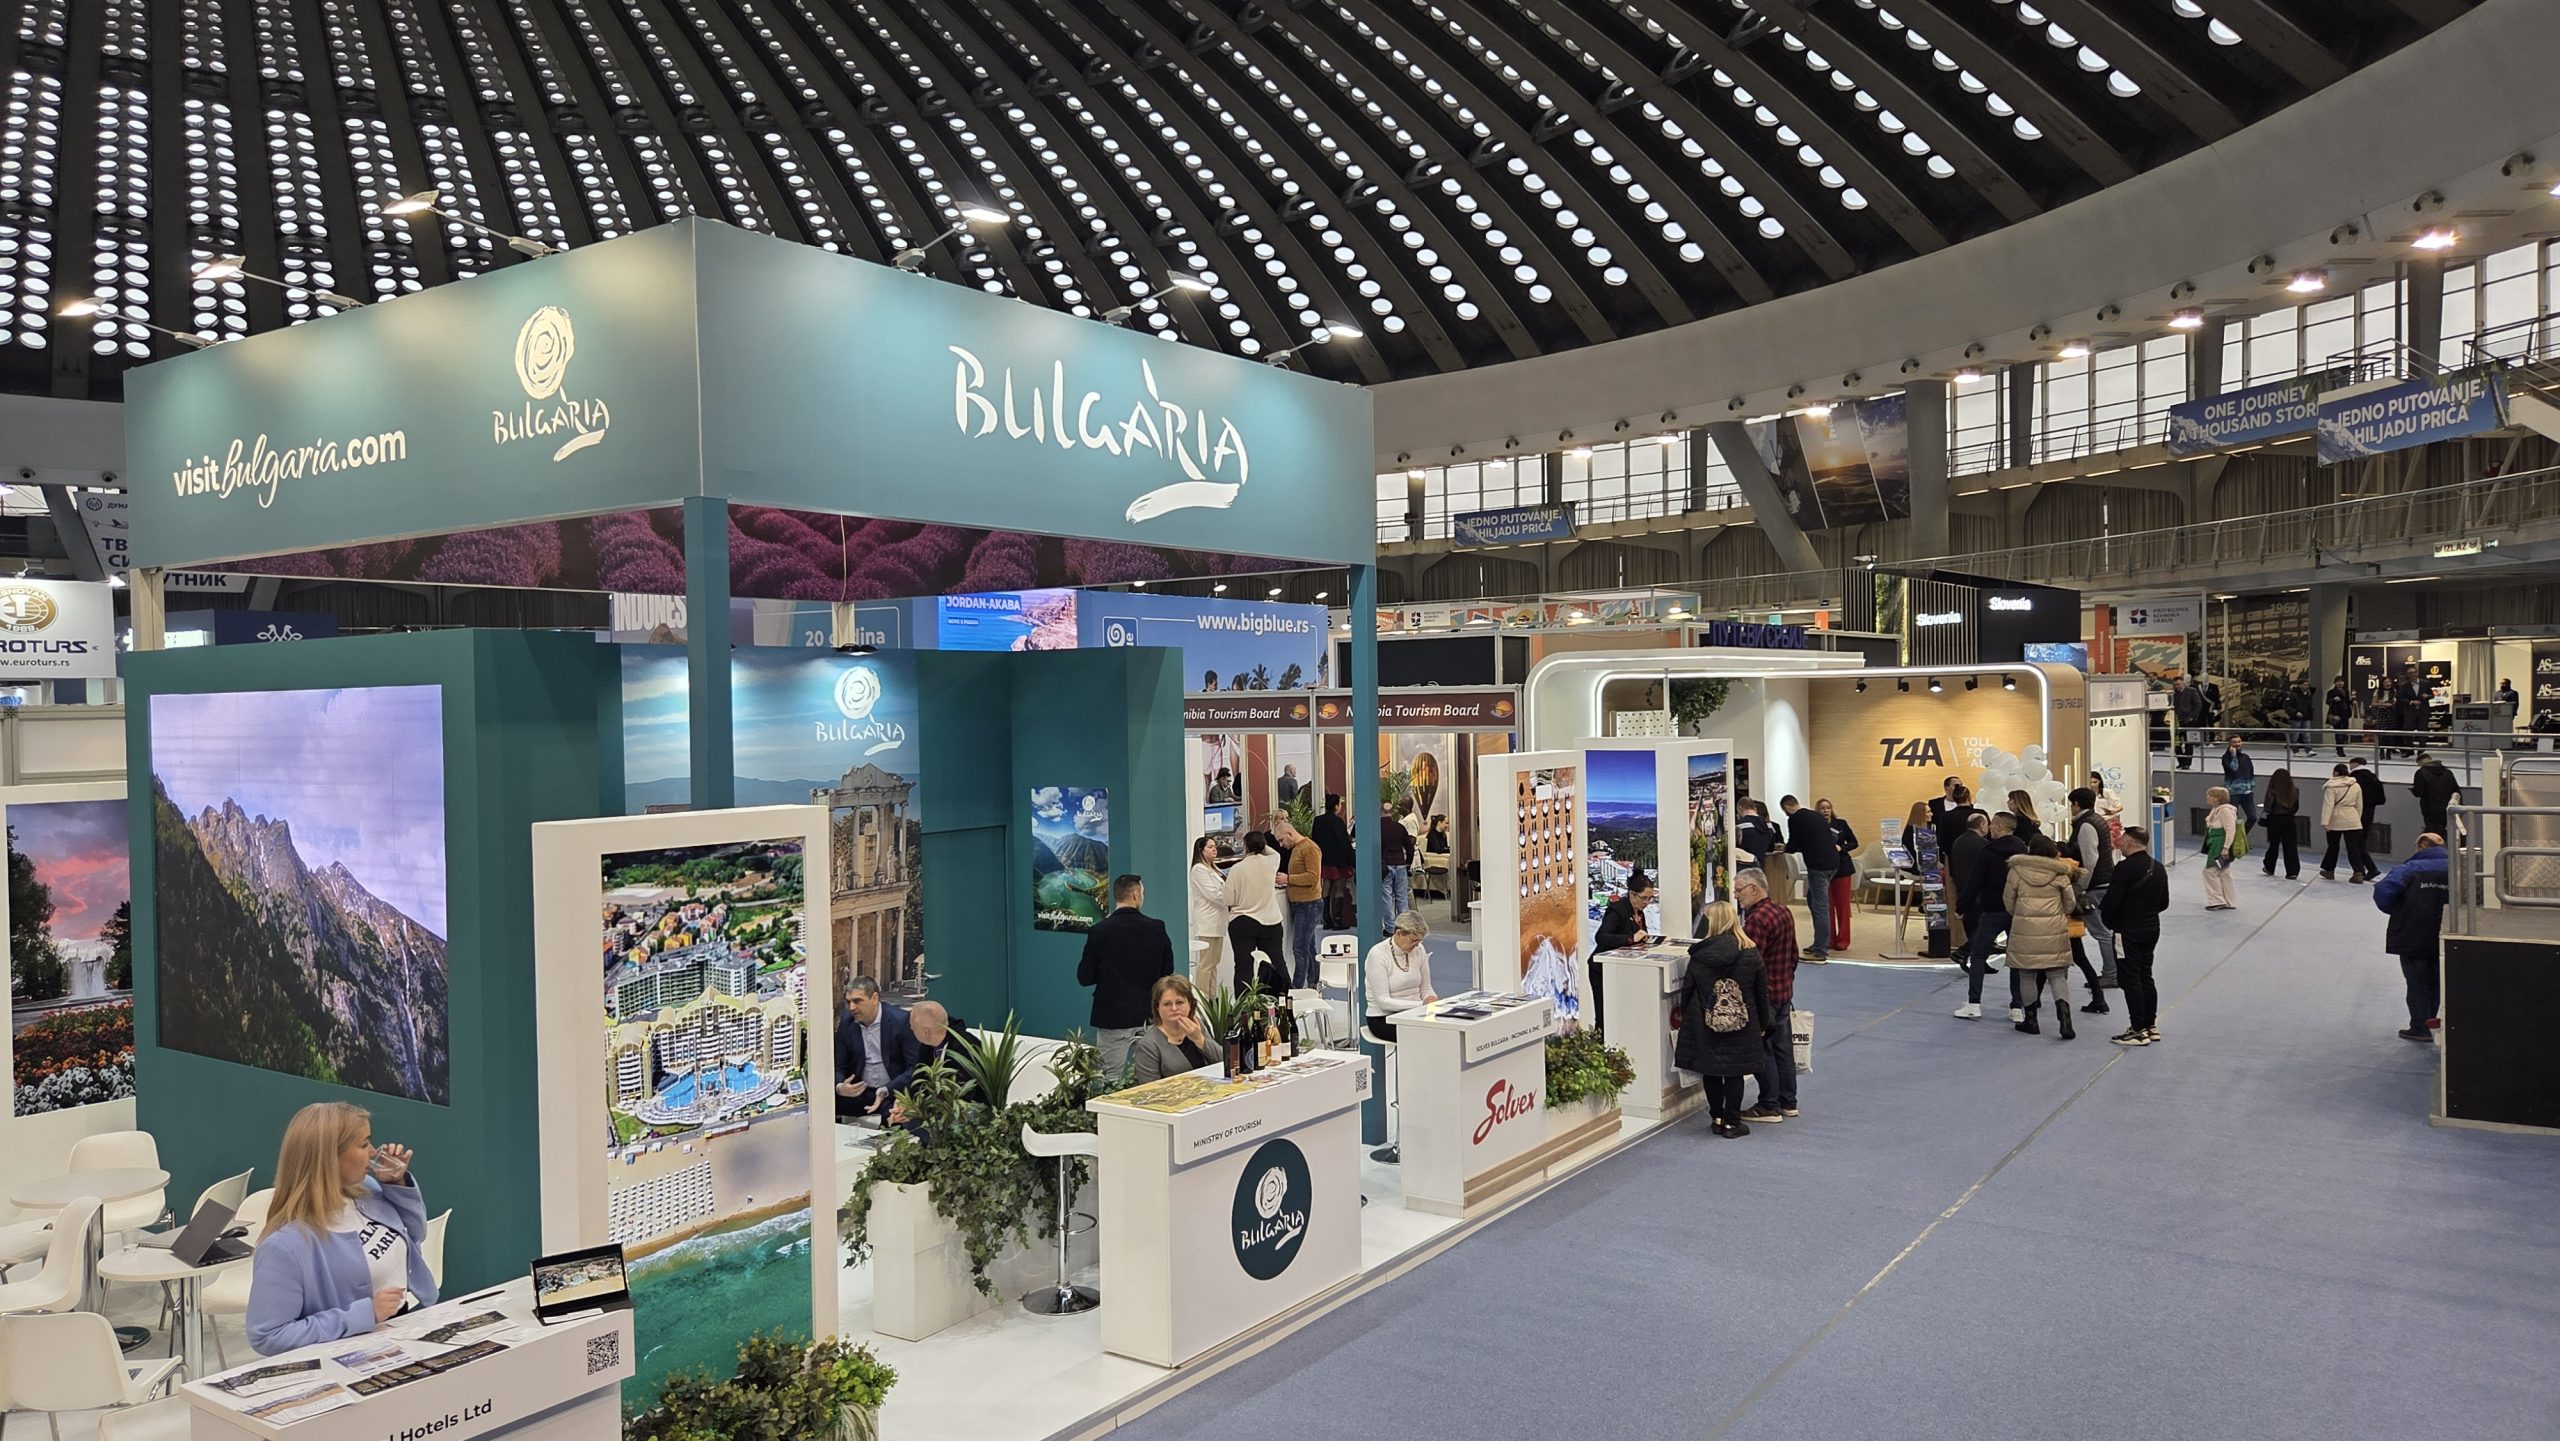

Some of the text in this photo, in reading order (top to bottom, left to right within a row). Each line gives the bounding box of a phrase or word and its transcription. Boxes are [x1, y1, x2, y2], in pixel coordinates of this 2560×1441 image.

[950, 346, 1249, 485] BULGARIA
[2204, 384, 2310, 421] ONE JOURNEY
[2335, 378, 2486, 434] JEDNO PUTOVANJE,
[493, 398, 611, 445] BULGARIA
[2177, 428, 2188, 444] A
[2189, 413, 2271, 441] THOUSAND
[2353, 404, 2470, 444] HILJADU PRIČA
[173, 429, 407, 509] visitbulgaria.com
[1467, 518, 1499, 530] JEDNO
[1478, 524, 1520, 539] HILJADU
[1989, 597, 2032, 611] Slovenia
[1197, 612, 1310, 637] www.bigblue.rs
[1915, 611, 1962, 627] Slovenia
[805, 630, 825, 647] 20
[1713, 621, 1809, 649] ПУТЕВИ СРБИЈЕ
[1208, 708, 1248, 720] Tourism
[1249, 707, 1281, 719] Board
[1394, 704, 1441, 719] Tourism
[1443, 703, 1480, 717] Board
[814, 719, 906, 745] BULGARIA
[1961, 737, 1993, 747] TOLL
[1879, 737, 1944, 768] T4A
[1966, 747, 1987, 758] FO
[1473, 1078, 1538, 1146] Solvex
[1193, 1118, 1262, 1149] MINISTRY OF TOURISM
[1241, 1209, 1305, 1250] BULGARIA
[400, 1398, 492, 1441] Hotels Ltd
